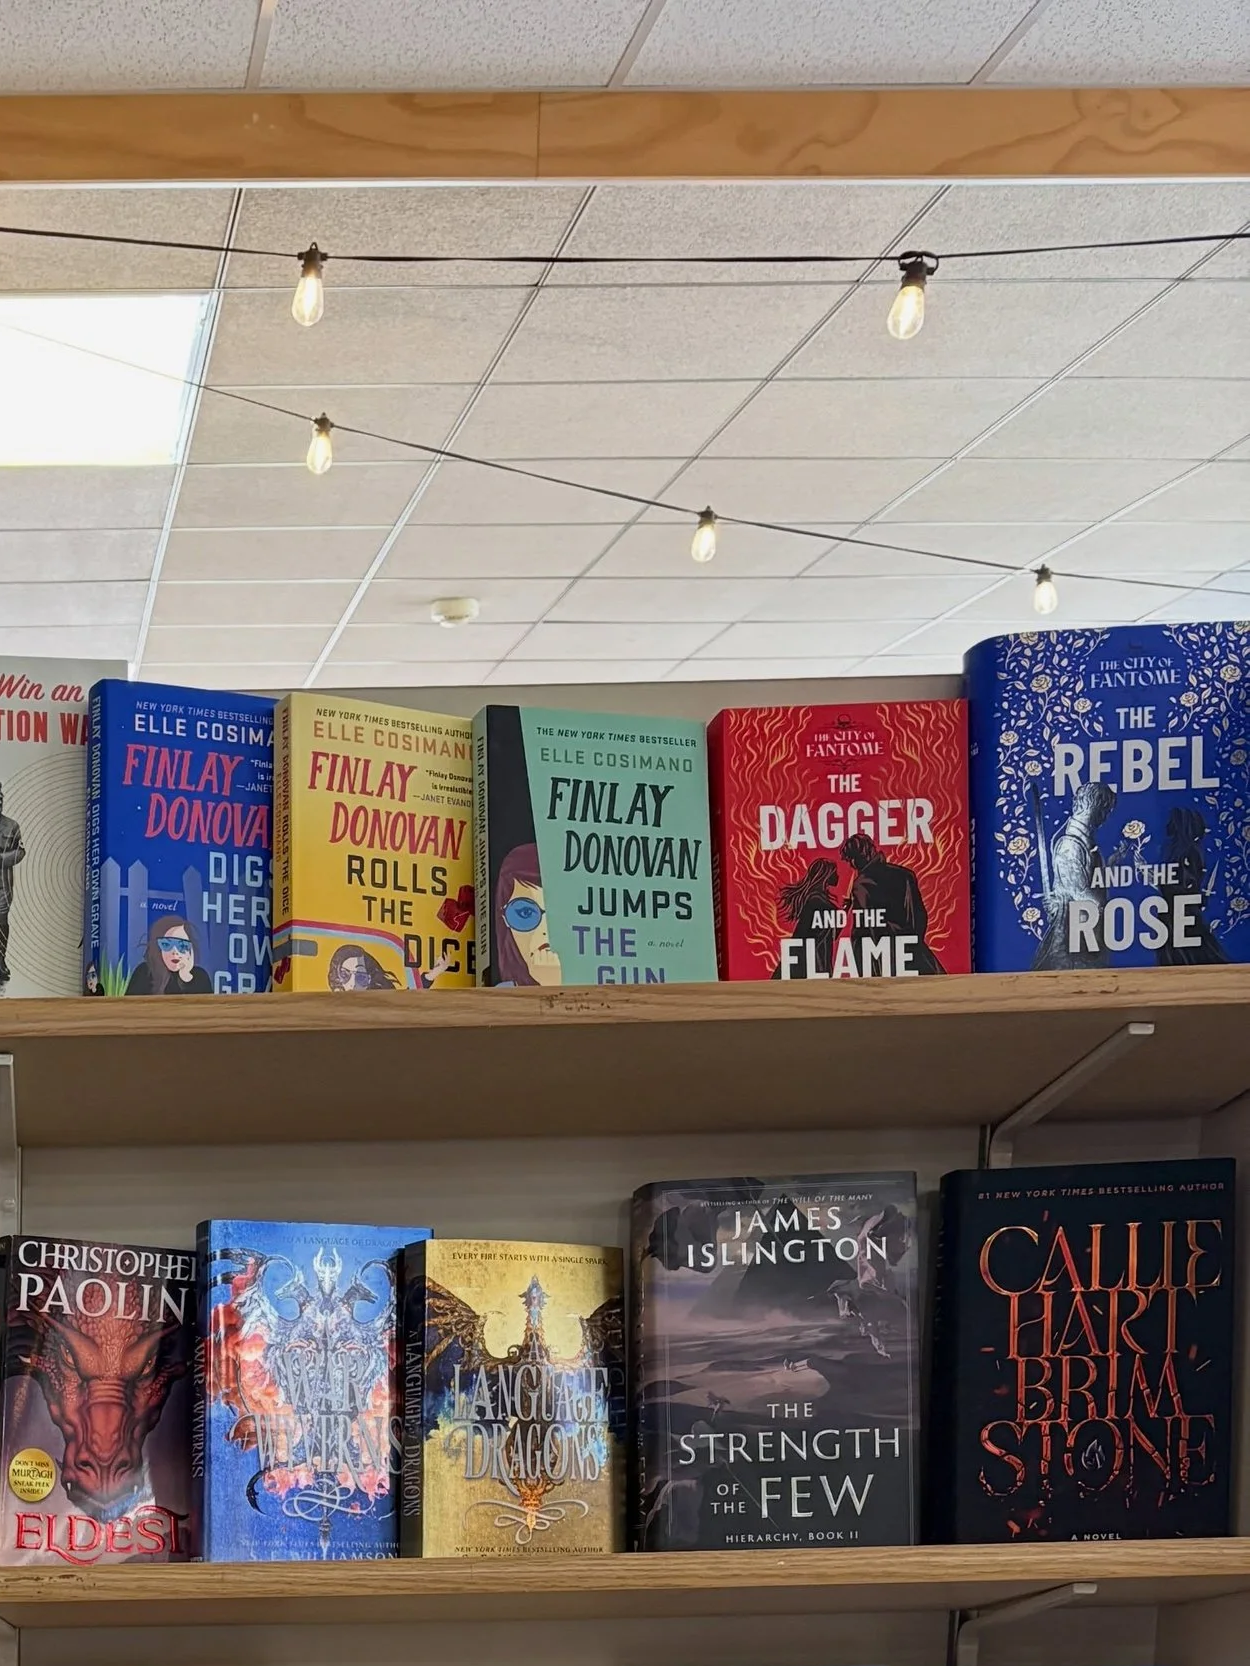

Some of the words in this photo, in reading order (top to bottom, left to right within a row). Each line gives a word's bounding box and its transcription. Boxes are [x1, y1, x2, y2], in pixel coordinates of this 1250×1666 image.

[1090, 668, 1181, 689] FANTOME
[1100, 659, 1121, 671] THE
[1124, 656, 1152, 669] CITY
[1155, 656, 1174, 668] OF
[51, 684, 84, 702] an
[1116, 705, 1156, 729] THE
[540, 747, 585, 765] ELLE
[593, 752, 693, 773] COSIMANO
[1053, 735, 1220, 797] REBEL
[547, 776, 674, 827] FINLAY
[828, 773, 862, 793] THE
[759, 797, 935, 851] DAGGER
[563, 830, 702, 880] DONOVAN
[1091, 864, 1132, 888] AND
[1135, 862, 1179, 886] THE
[577, 886, 692, 920] JUMPS
[572, 926, 637, 958] THE
[1069, 894, 1203, 953] ROSE
[780, 935, 920, 980] FLAME
[733, 1205, 843, 1241] JAMES
[687, 1237, 888, 1269] ISLINGTON
[979, 1220, 1223, 1297] CALLIE
[1009, 1288, 1185, 1359] HART
[451, 1363, 609, 1425] LANGUAGE
[1014, 1354, 1190, 1423] BRIM
[767, 1403, 813, 1419] THE
[462, 1421, 602, 1496] DRAGONS
[678, 1428, 901, 1466] STRENGTH
[979, 1415, 1216, 1502] STONE
[710, 1501, 746, 1515] THE
[717, 1483, 740, 1497] OF
[760, 1473, 874, 1519] FEW
[15, 1505, 190, 1565] ELDEST
[725, 1533, 801, 1544] HIERARCHY,
[808, 1531, 844, 1542] BOOK
[850, 1531, 859, 1540] II
